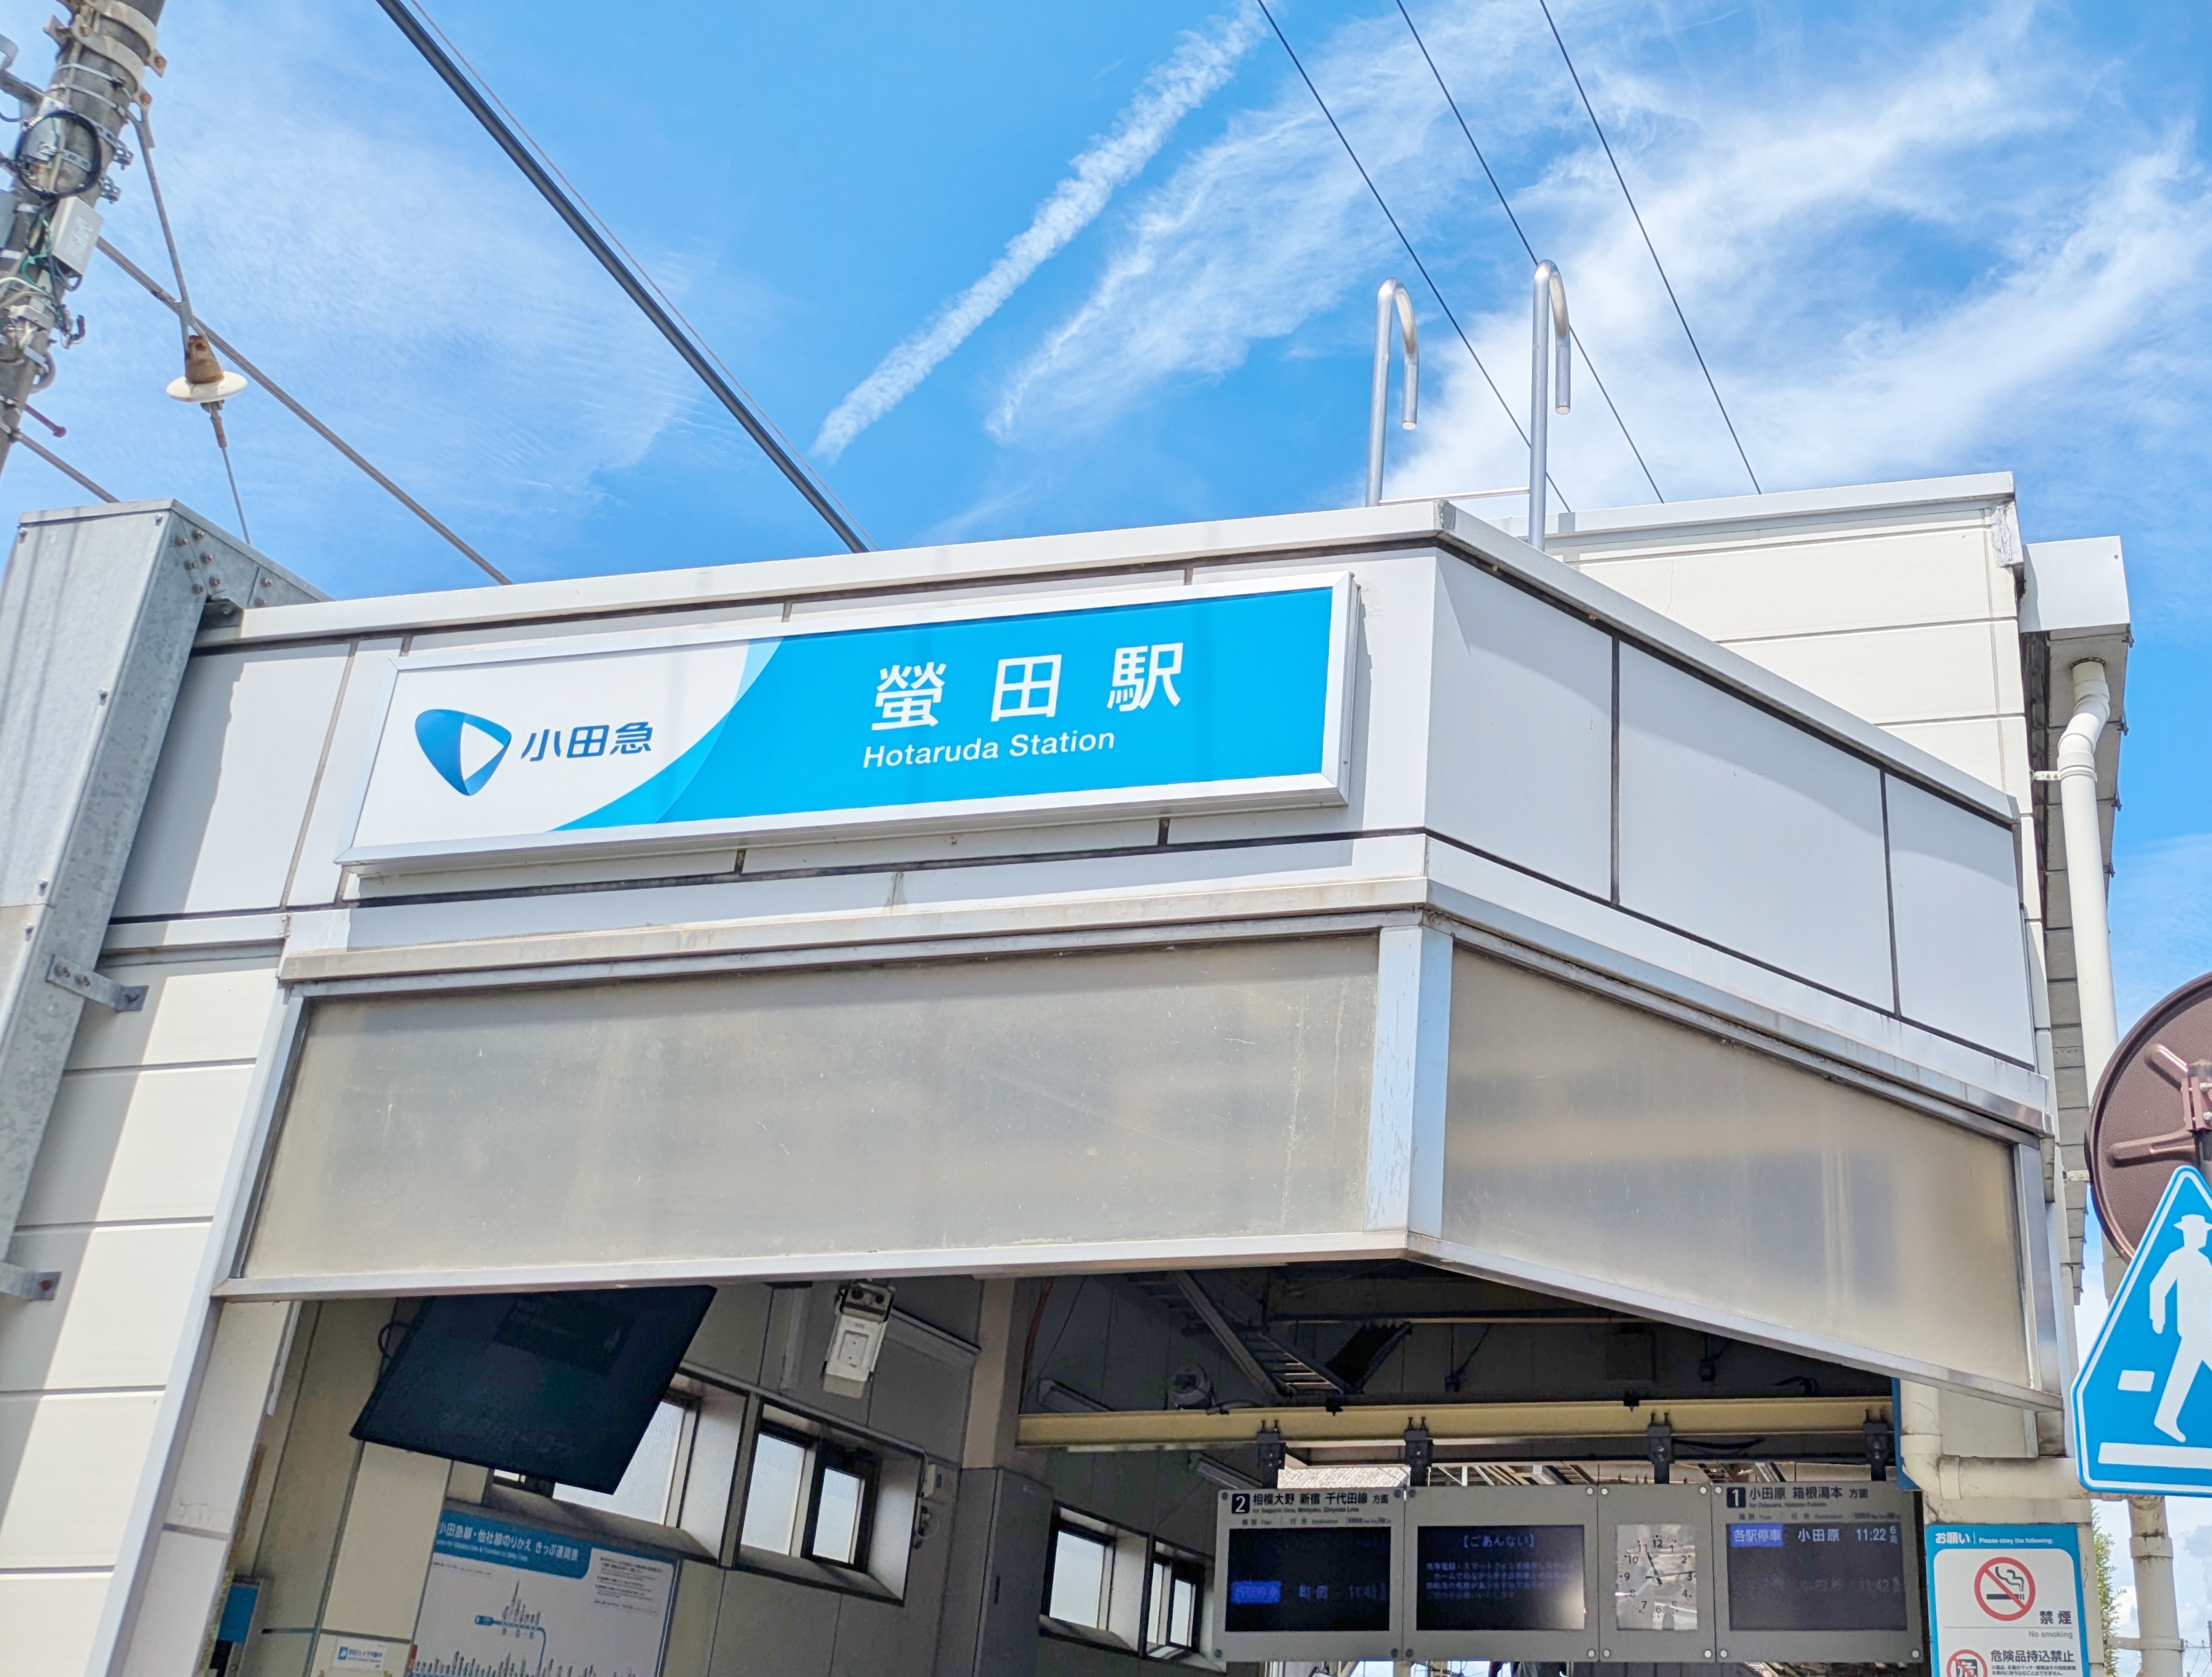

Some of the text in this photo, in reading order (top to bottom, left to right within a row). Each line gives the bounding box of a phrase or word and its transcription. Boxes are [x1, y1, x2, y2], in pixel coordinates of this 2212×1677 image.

[520, 721, 654, 763] 小田急
[863, 730, 1115, 768] Hotaruda Station
[1749, 1487, 1786, 1500] 小田原
[1792, 1486, 1843, 1500] 箱根湯本
[1848, 1489, 1868, 1499] 方面
[1235, 1492, 1389, 1513] 2 相模大野 新宿 千代田線 方面
[1733, 1528, 1782, 1543] 各駅停車
[1797, 1527, 1840, 1543] 小田原
[1856, 1528, 1887, 1542] 11:22
[1935, 1531, 1970, 1544] お願い
[1637, 1544, 1647, 1552] 11
[1624, 1572, 1630, 1581] 9
[1682, 1589, 1688, 1598] 4
[1641, 1601, 1647, 1609] 7
[2039, 1610, 2073, 1625] 禁煙
[2041, 1631, 2073, 1639] smoking
[1990, 1650, 2075, 1663] 危険品持込禁止
